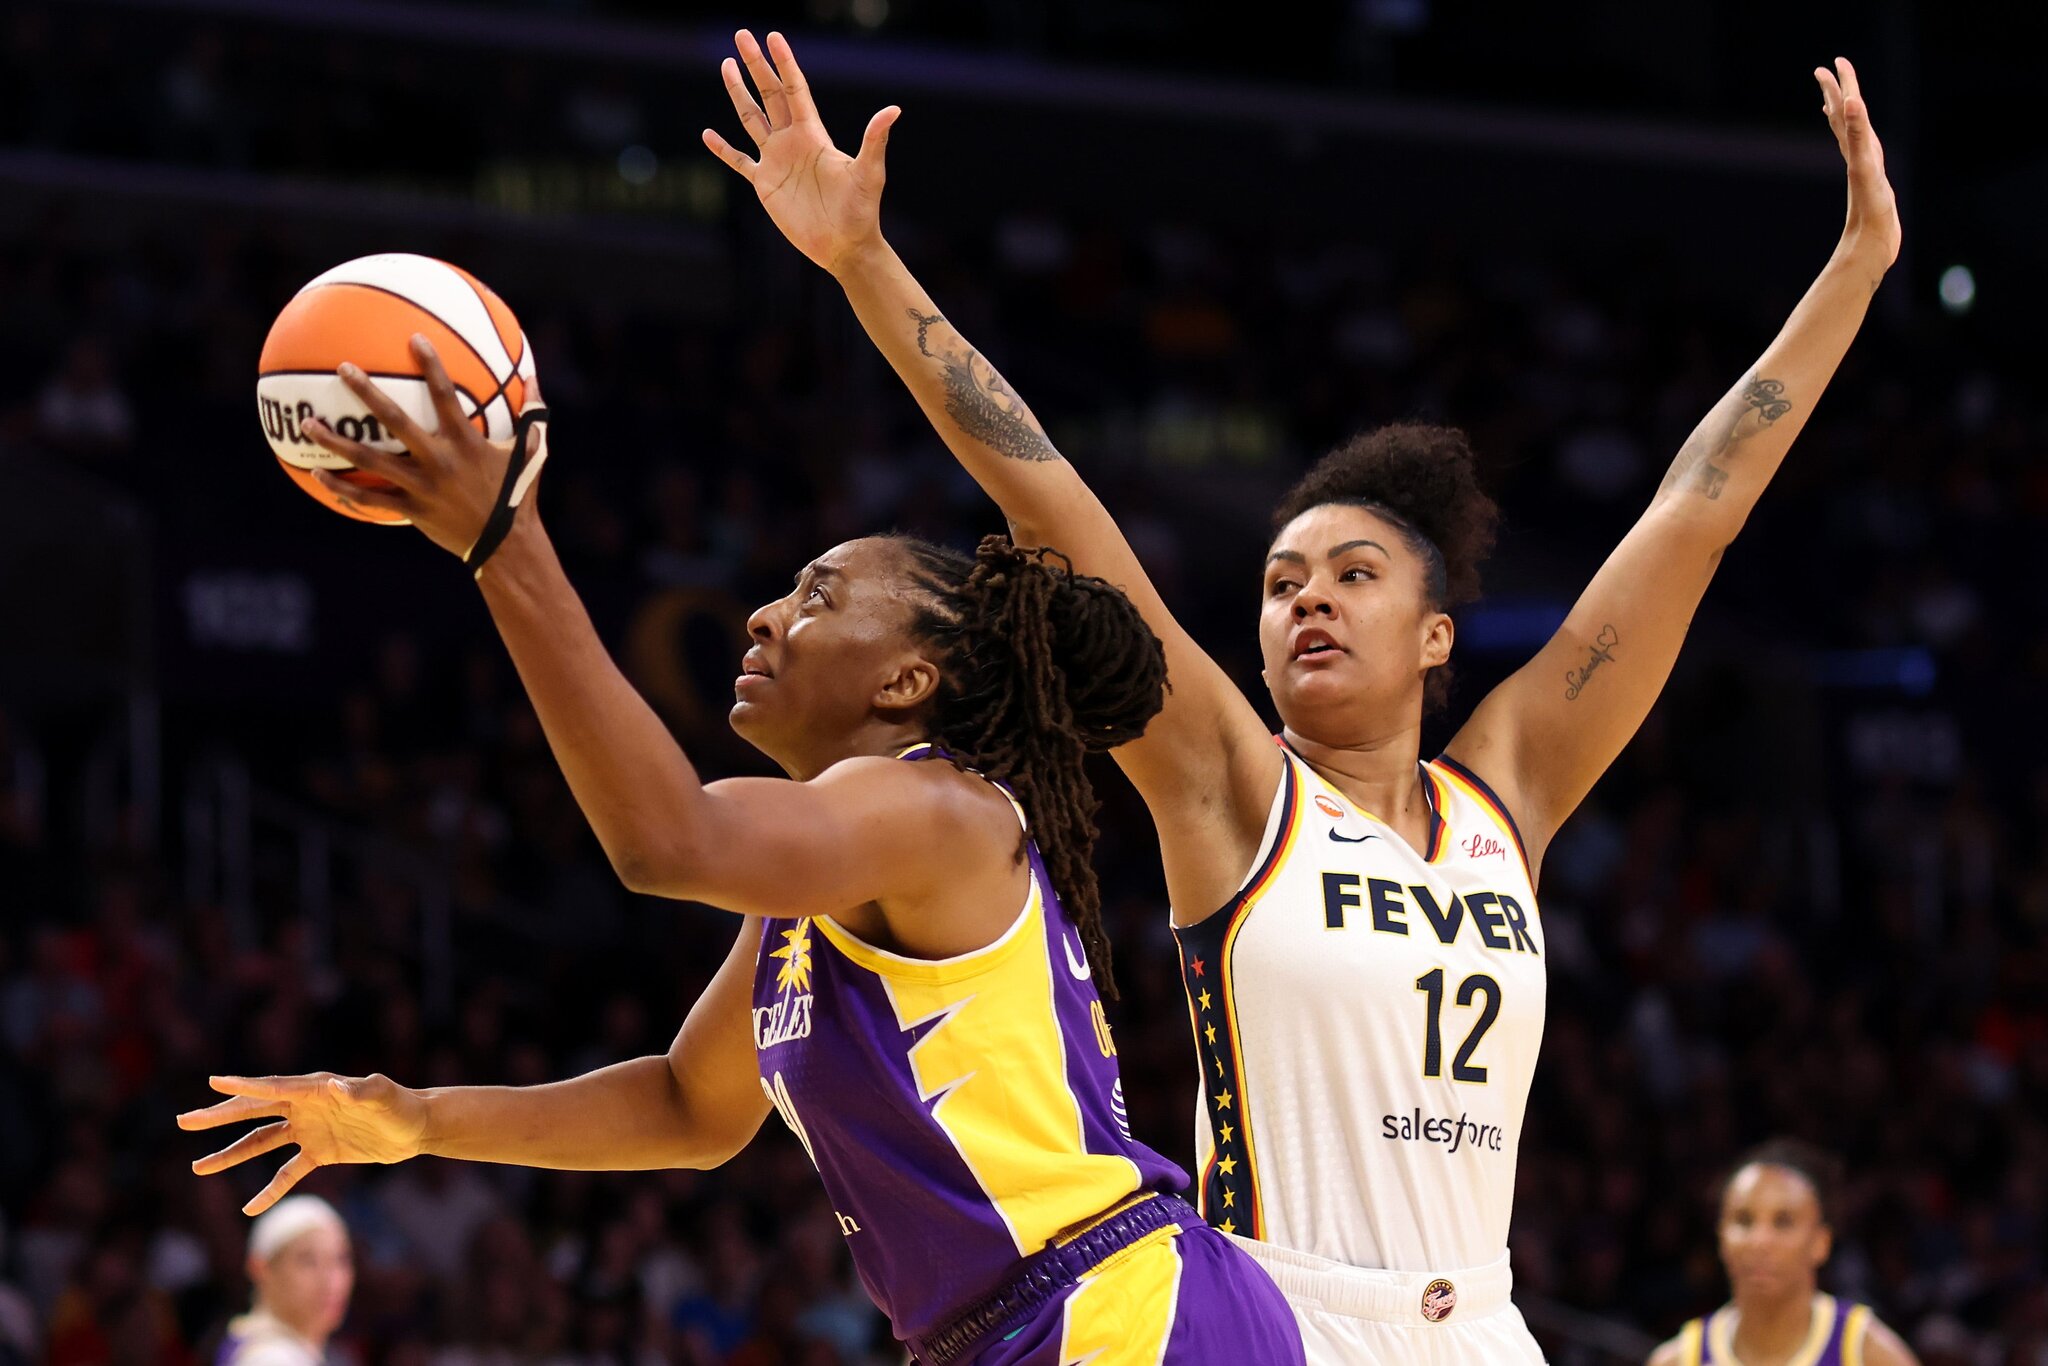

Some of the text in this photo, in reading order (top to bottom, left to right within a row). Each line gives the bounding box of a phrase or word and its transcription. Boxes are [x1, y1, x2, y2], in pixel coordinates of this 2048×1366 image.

[1462, 834, 1505, 861] Lilly
[1320, 871, 1540, 956] FEVER
[1414, 966, 1503, 1084] 12
[1382, 1107, 1502, 1153] salesforce
